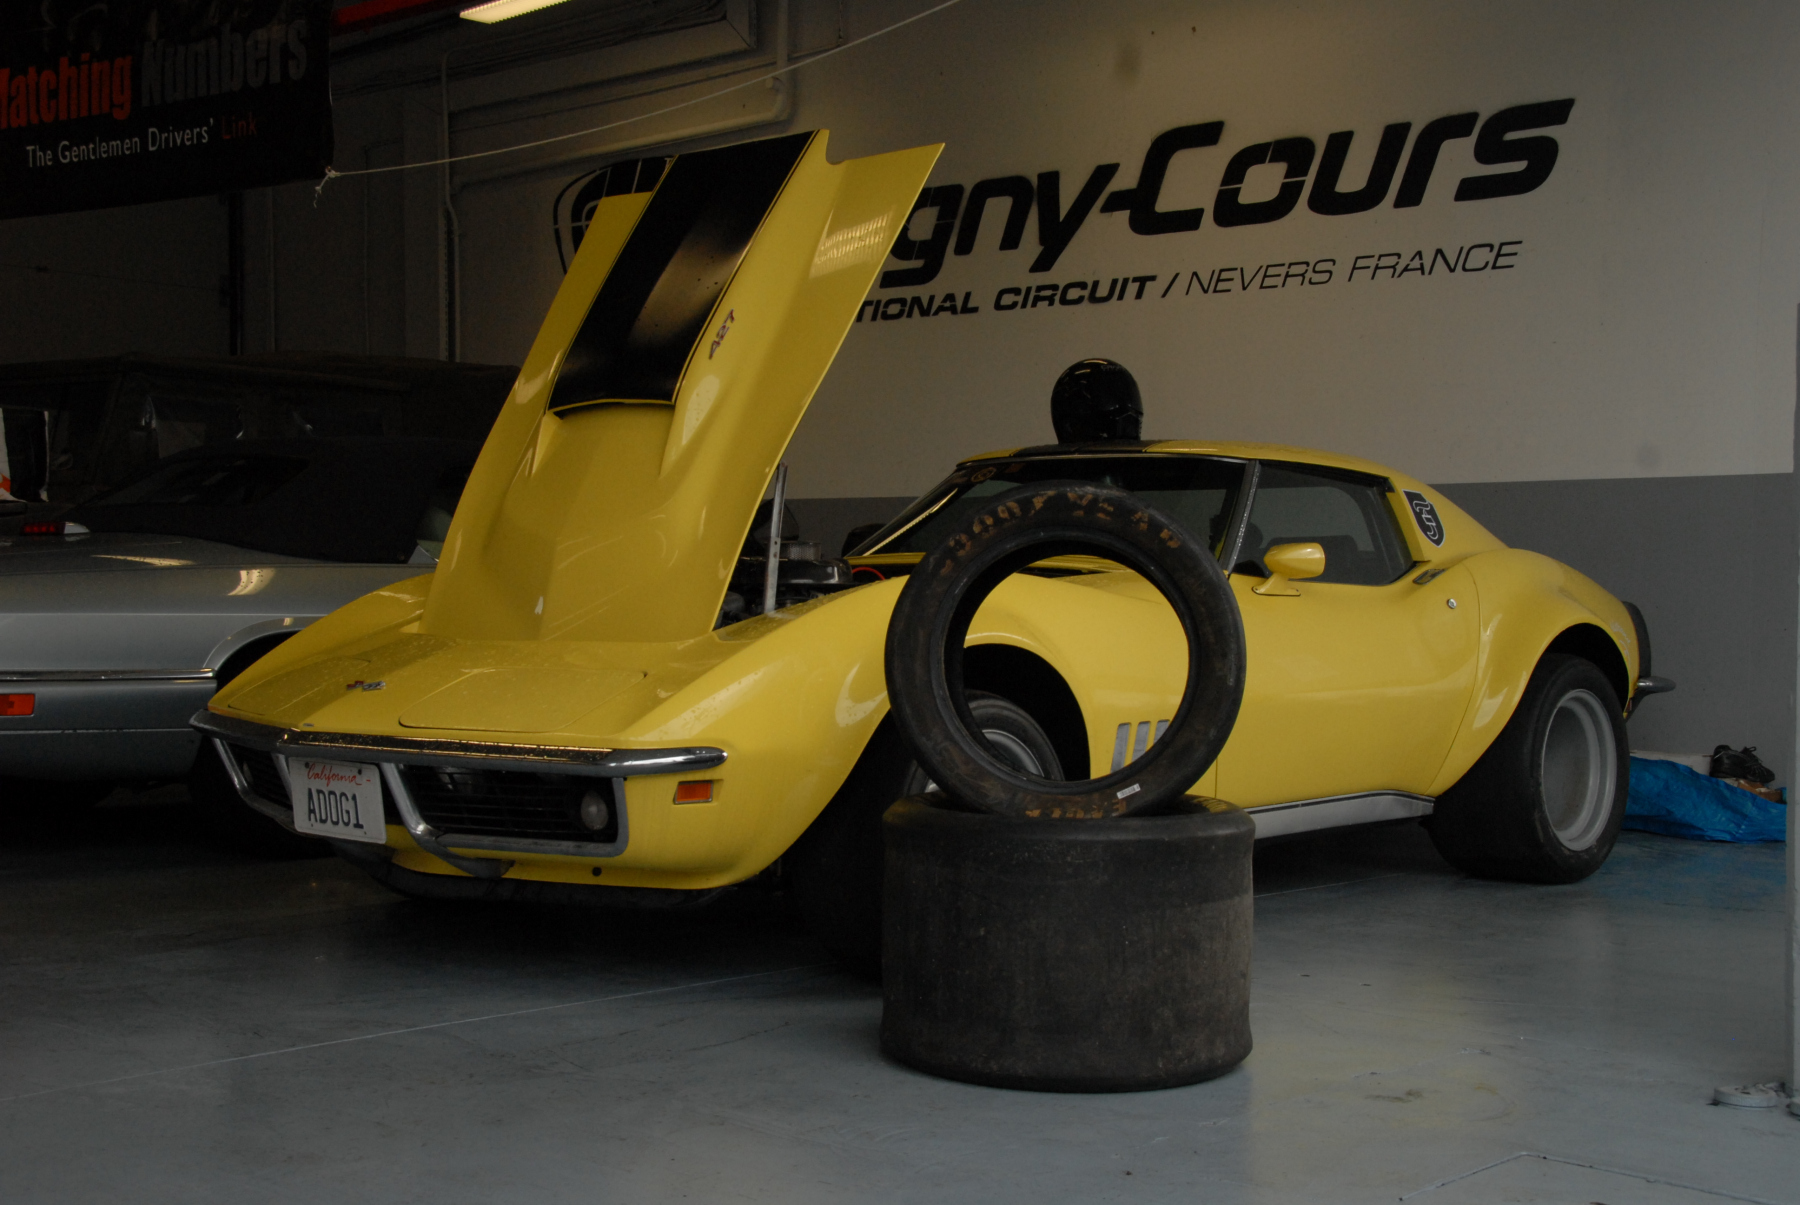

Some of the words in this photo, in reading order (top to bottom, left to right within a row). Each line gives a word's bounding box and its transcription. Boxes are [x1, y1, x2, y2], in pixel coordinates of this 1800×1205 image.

[141, 19, 307, 107] Numbers
[26, 145, 53, 168] The
[58, 136, 141, 165] Gentlemen
[148, 117, 214, 152] Drivers'
[221, 111, 258, 140] Link
[880, 98, 1575, 289] gny-Cours
[856, 291, 979, 322] TIONAL
[994, 275, 1157, 311] CIRCUIT
[1185, 259, 1336, 297] NEVERS
[1348, 241, 1523, 282] FRANCE
[708, 308, 735, 360] 427
[307, 762, 362, 787] California
[308, 788, 364, 829] ADOG1
